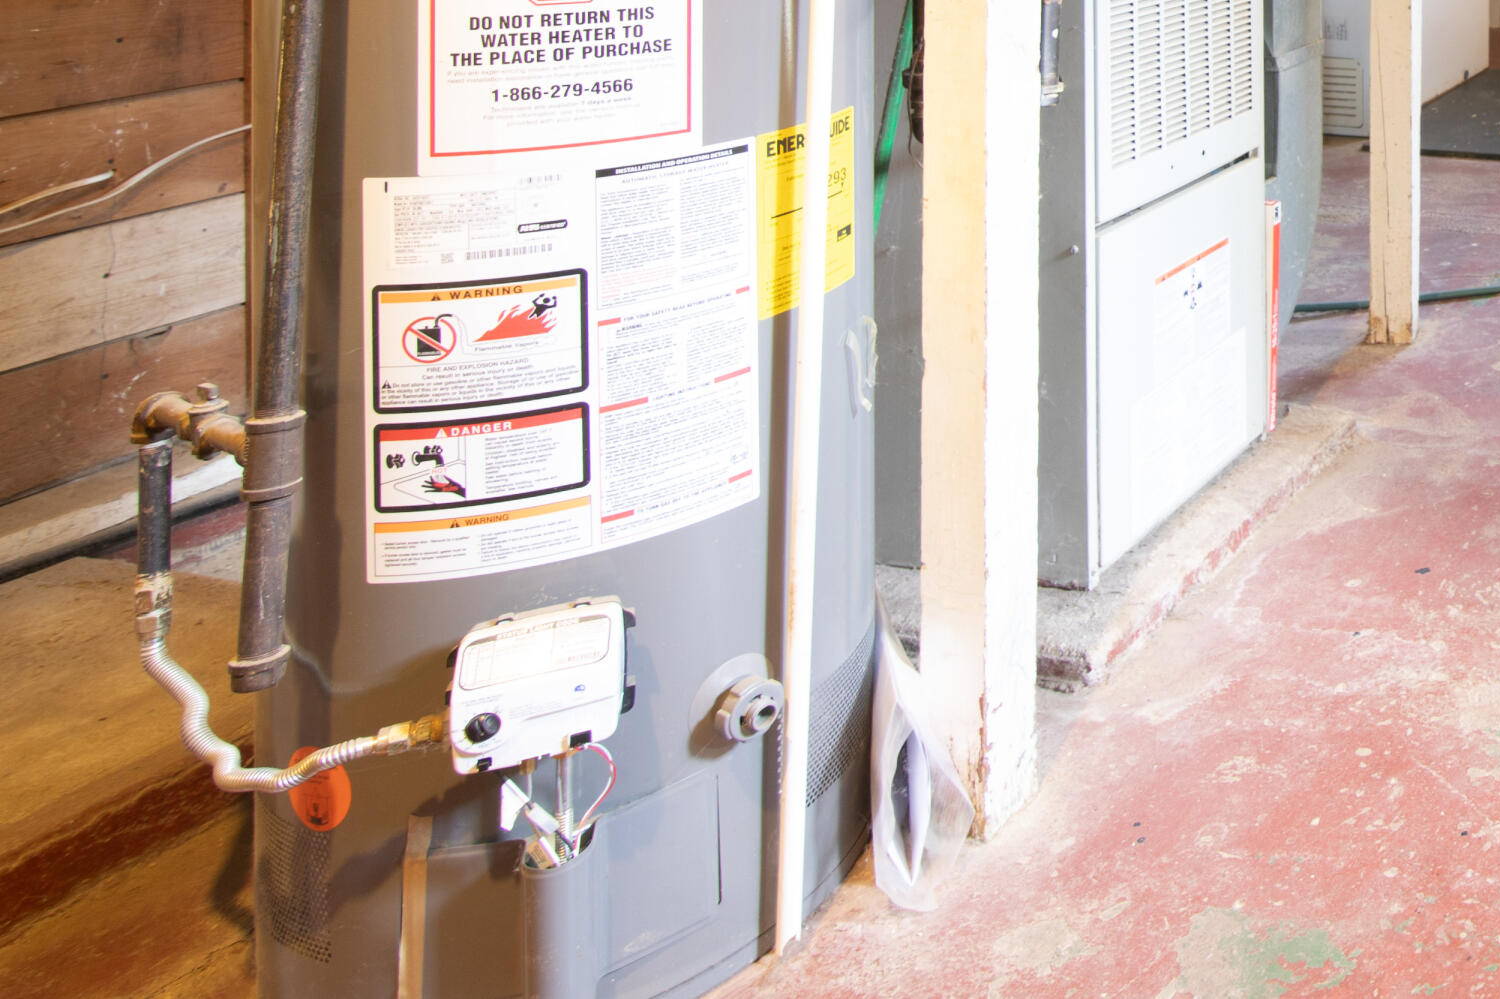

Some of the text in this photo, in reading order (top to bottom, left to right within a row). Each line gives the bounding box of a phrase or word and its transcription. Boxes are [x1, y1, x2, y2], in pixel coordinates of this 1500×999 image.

[469, 6, 655, 30] DO NOT RETURN THIS
[481, 24, 644, 47] WATER HEATER TO
[450, 39, 673, 67] THE PLACE OF PURCHASE
[491, 79, 633, 102] 1-866-279-4566
[615, 162, 661, 175] INSTALLATION
[662, 159, 676, 167] AND
[676, 153, 710, 165] OPERATION
[450, 285, 524, 300] WARNING
[459, 361, 498, 371] EXPLOSION
[451, 421, 513, 437] DANGER
[465, 513, 510, 527] WARNING
